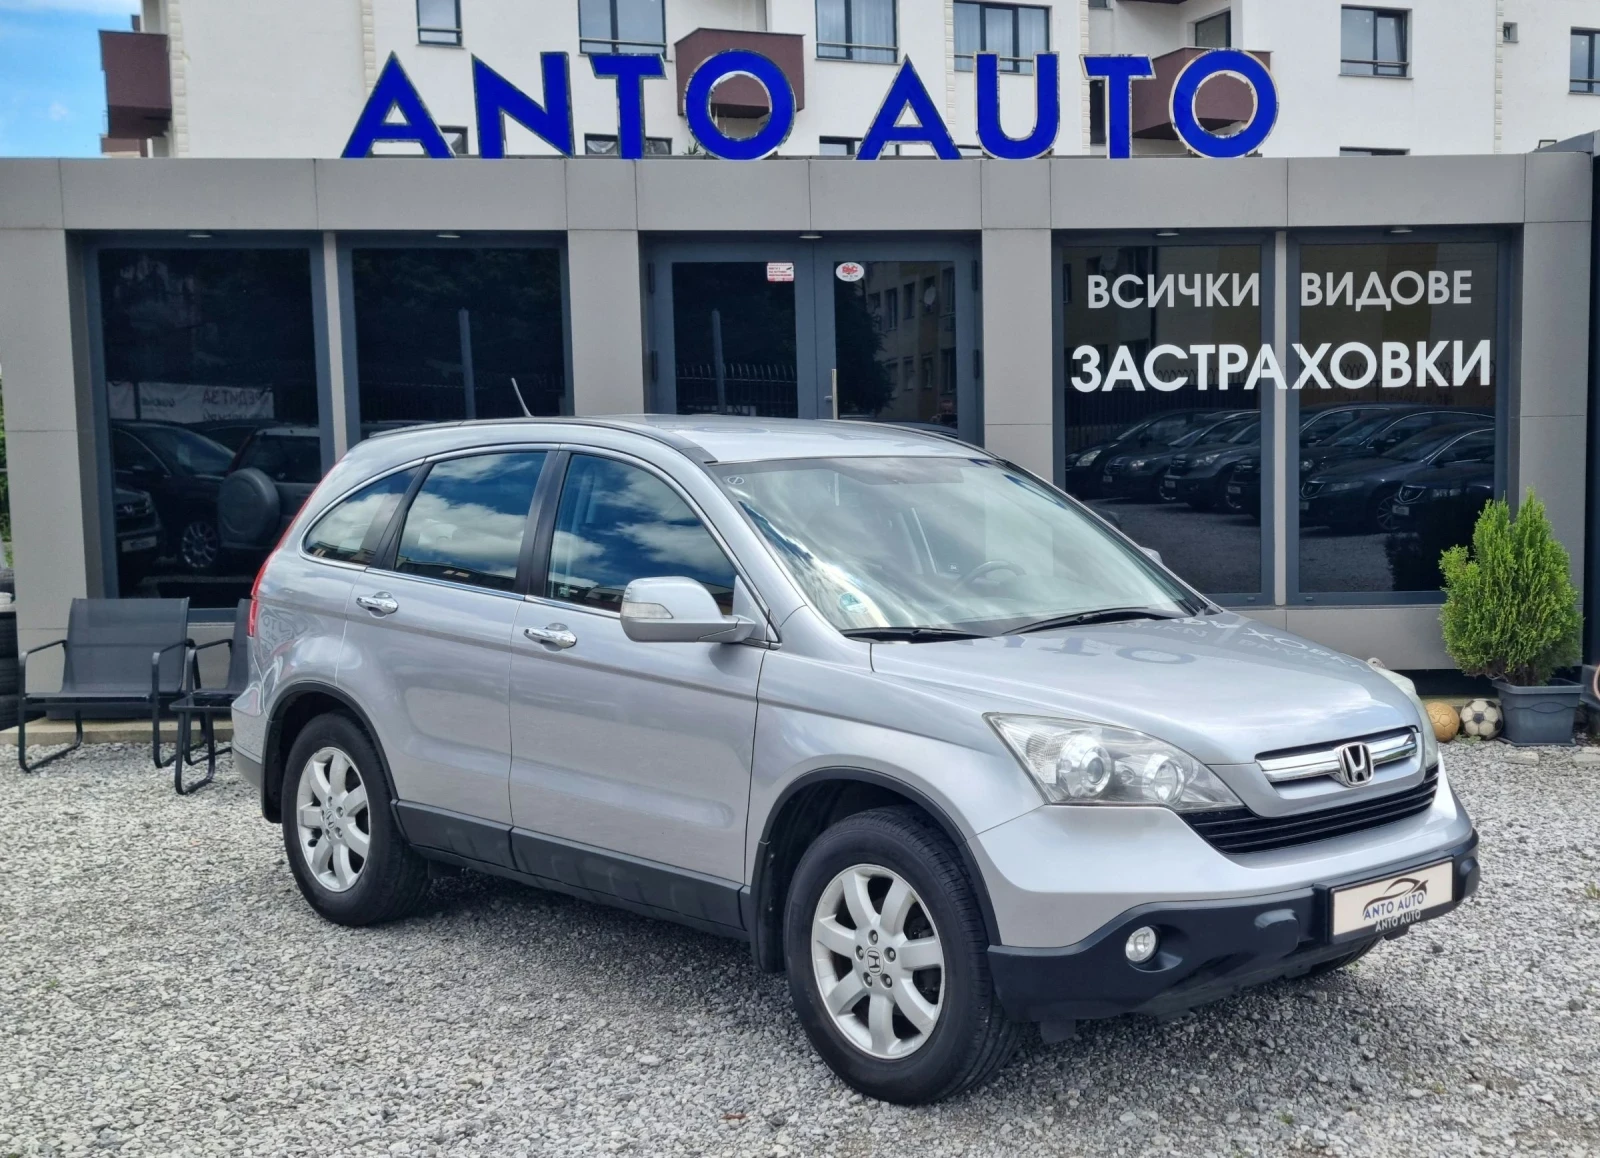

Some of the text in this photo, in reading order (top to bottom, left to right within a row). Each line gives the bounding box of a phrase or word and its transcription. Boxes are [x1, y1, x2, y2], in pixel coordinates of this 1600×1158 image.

[342, 48, 1279, 160] ANTO AUTO
[1087, 270, 1472, 311] ВСИЧКИ ВИДОВЕ
[1071, 339, 1491, 393] ЗАСТРАХОВКИ
[1364, 892, 1424, 920] ANTO AUTO
[1375, 910, 1421, 932] ANTO AUTO
